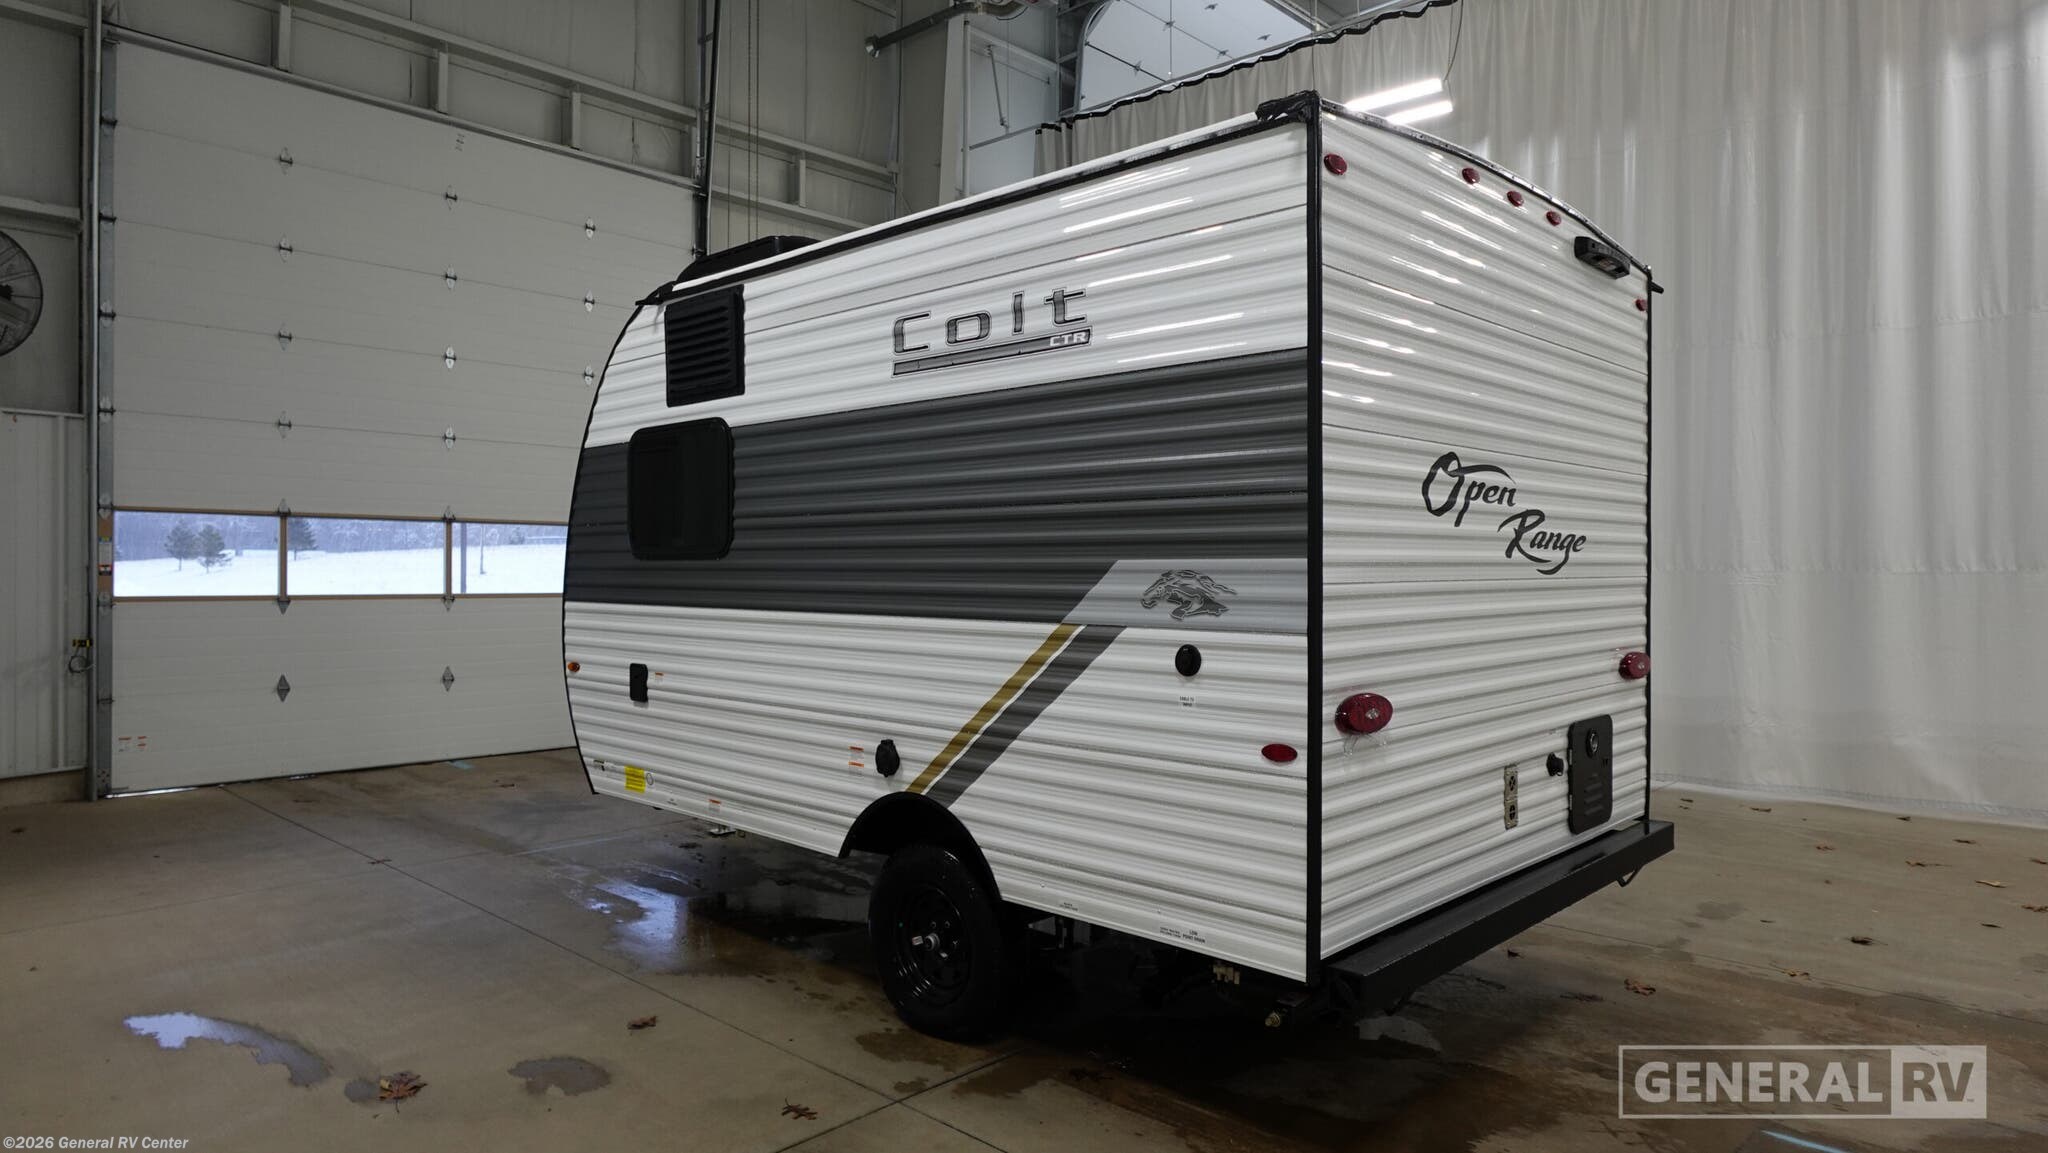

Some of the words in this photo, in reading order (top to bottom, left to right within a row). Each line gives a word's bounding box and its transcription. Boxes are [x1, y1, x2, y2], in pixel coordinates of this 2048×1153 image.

[893, 288, 1087, 353] Colt
[1049, 330, 1088, 347] CTR
[1421, 451, 1518, 528] Open
[1497, 508, 1587, 576] Range
